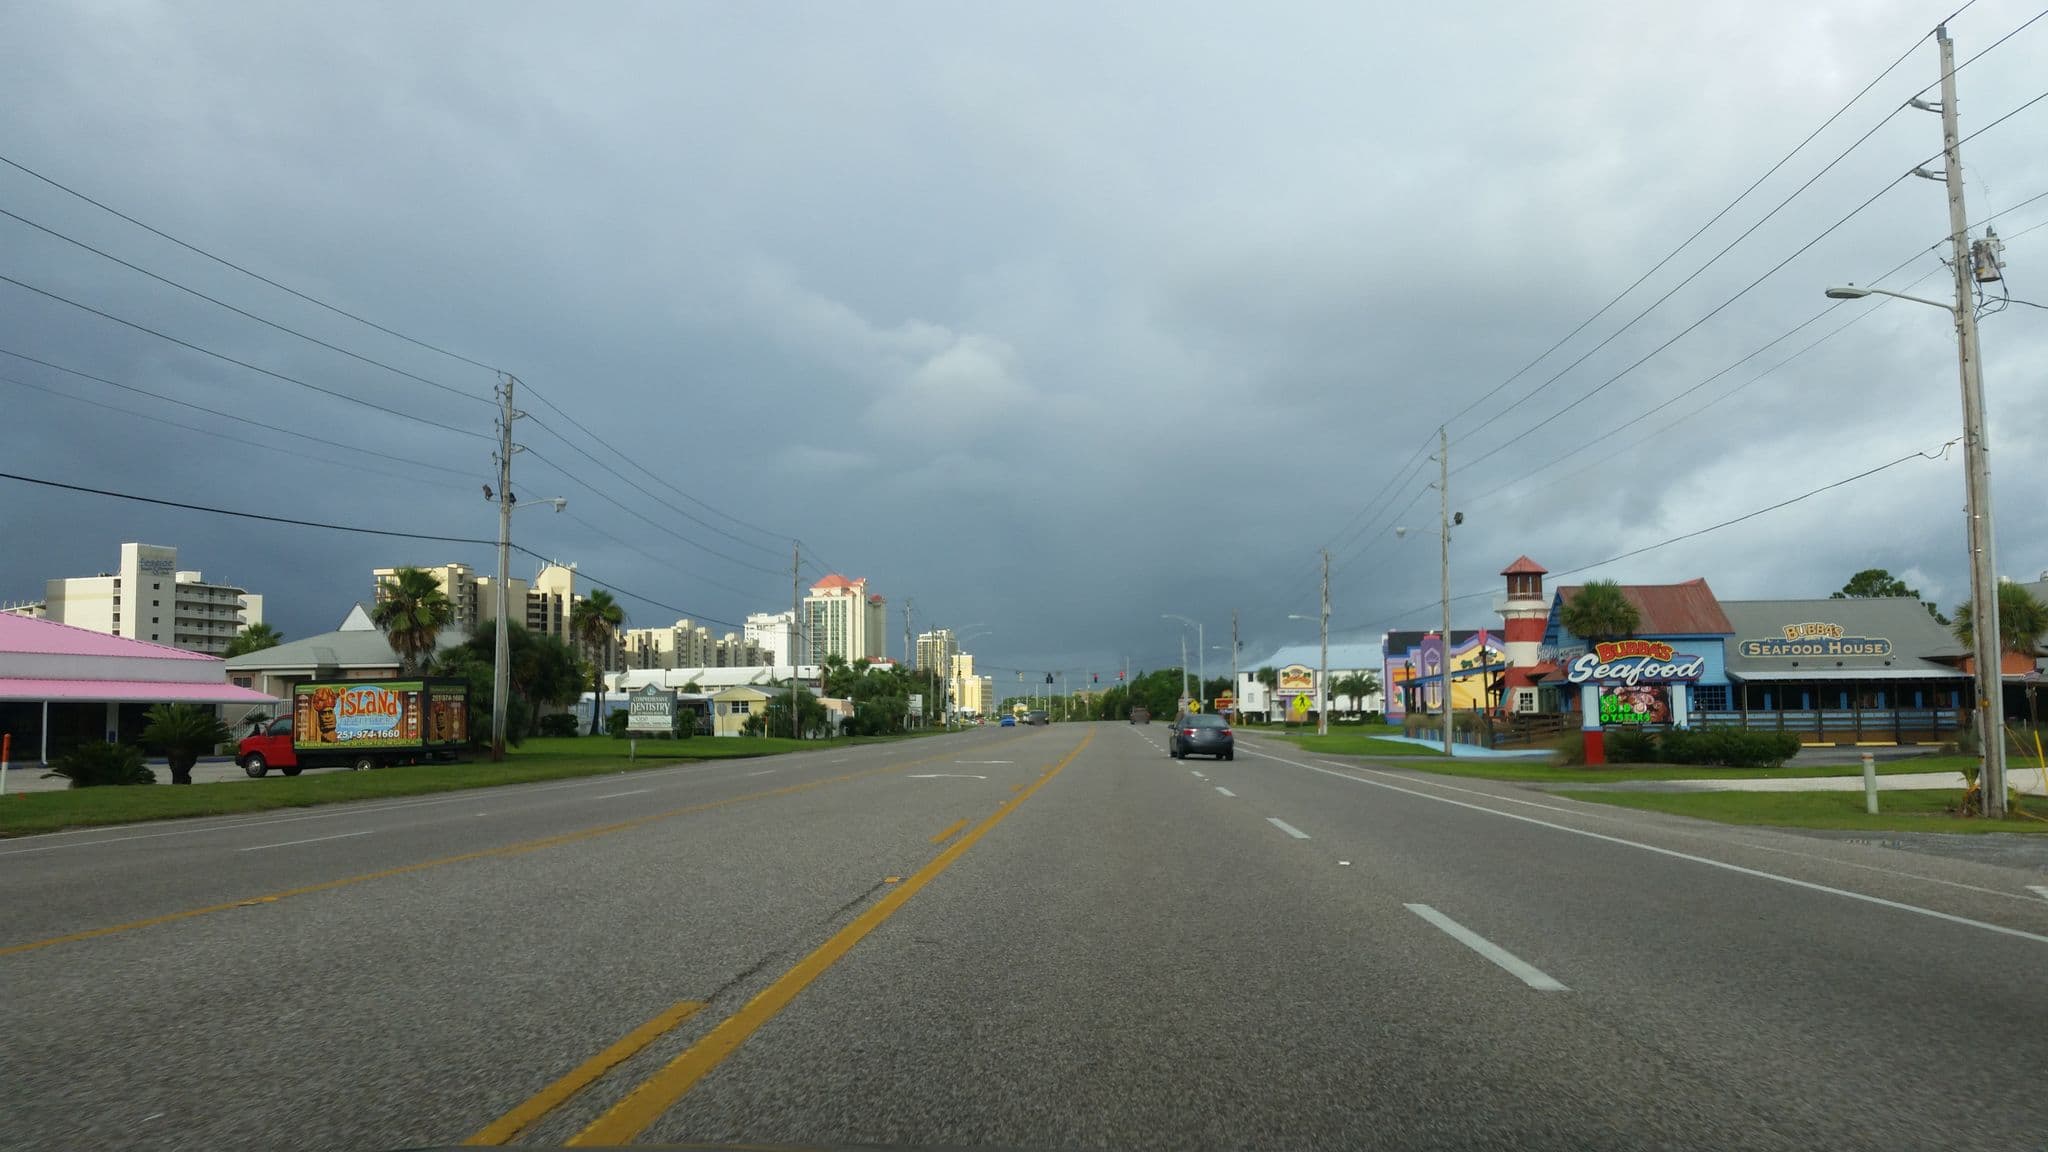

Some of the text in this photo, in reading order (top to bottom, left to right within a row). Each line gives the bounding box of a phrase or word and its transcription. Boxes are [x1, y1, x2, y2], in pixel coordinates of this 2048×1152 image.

[1596, 641, 1673, 663] BUBBA'S
[1568, 653, 1703, 686] Seafood
[630, 702, 670, 715] DENTISTRY
[1600, 713, 1651, 722] OYSTERS
[336, 730, 400, 740] 251-974-1660
